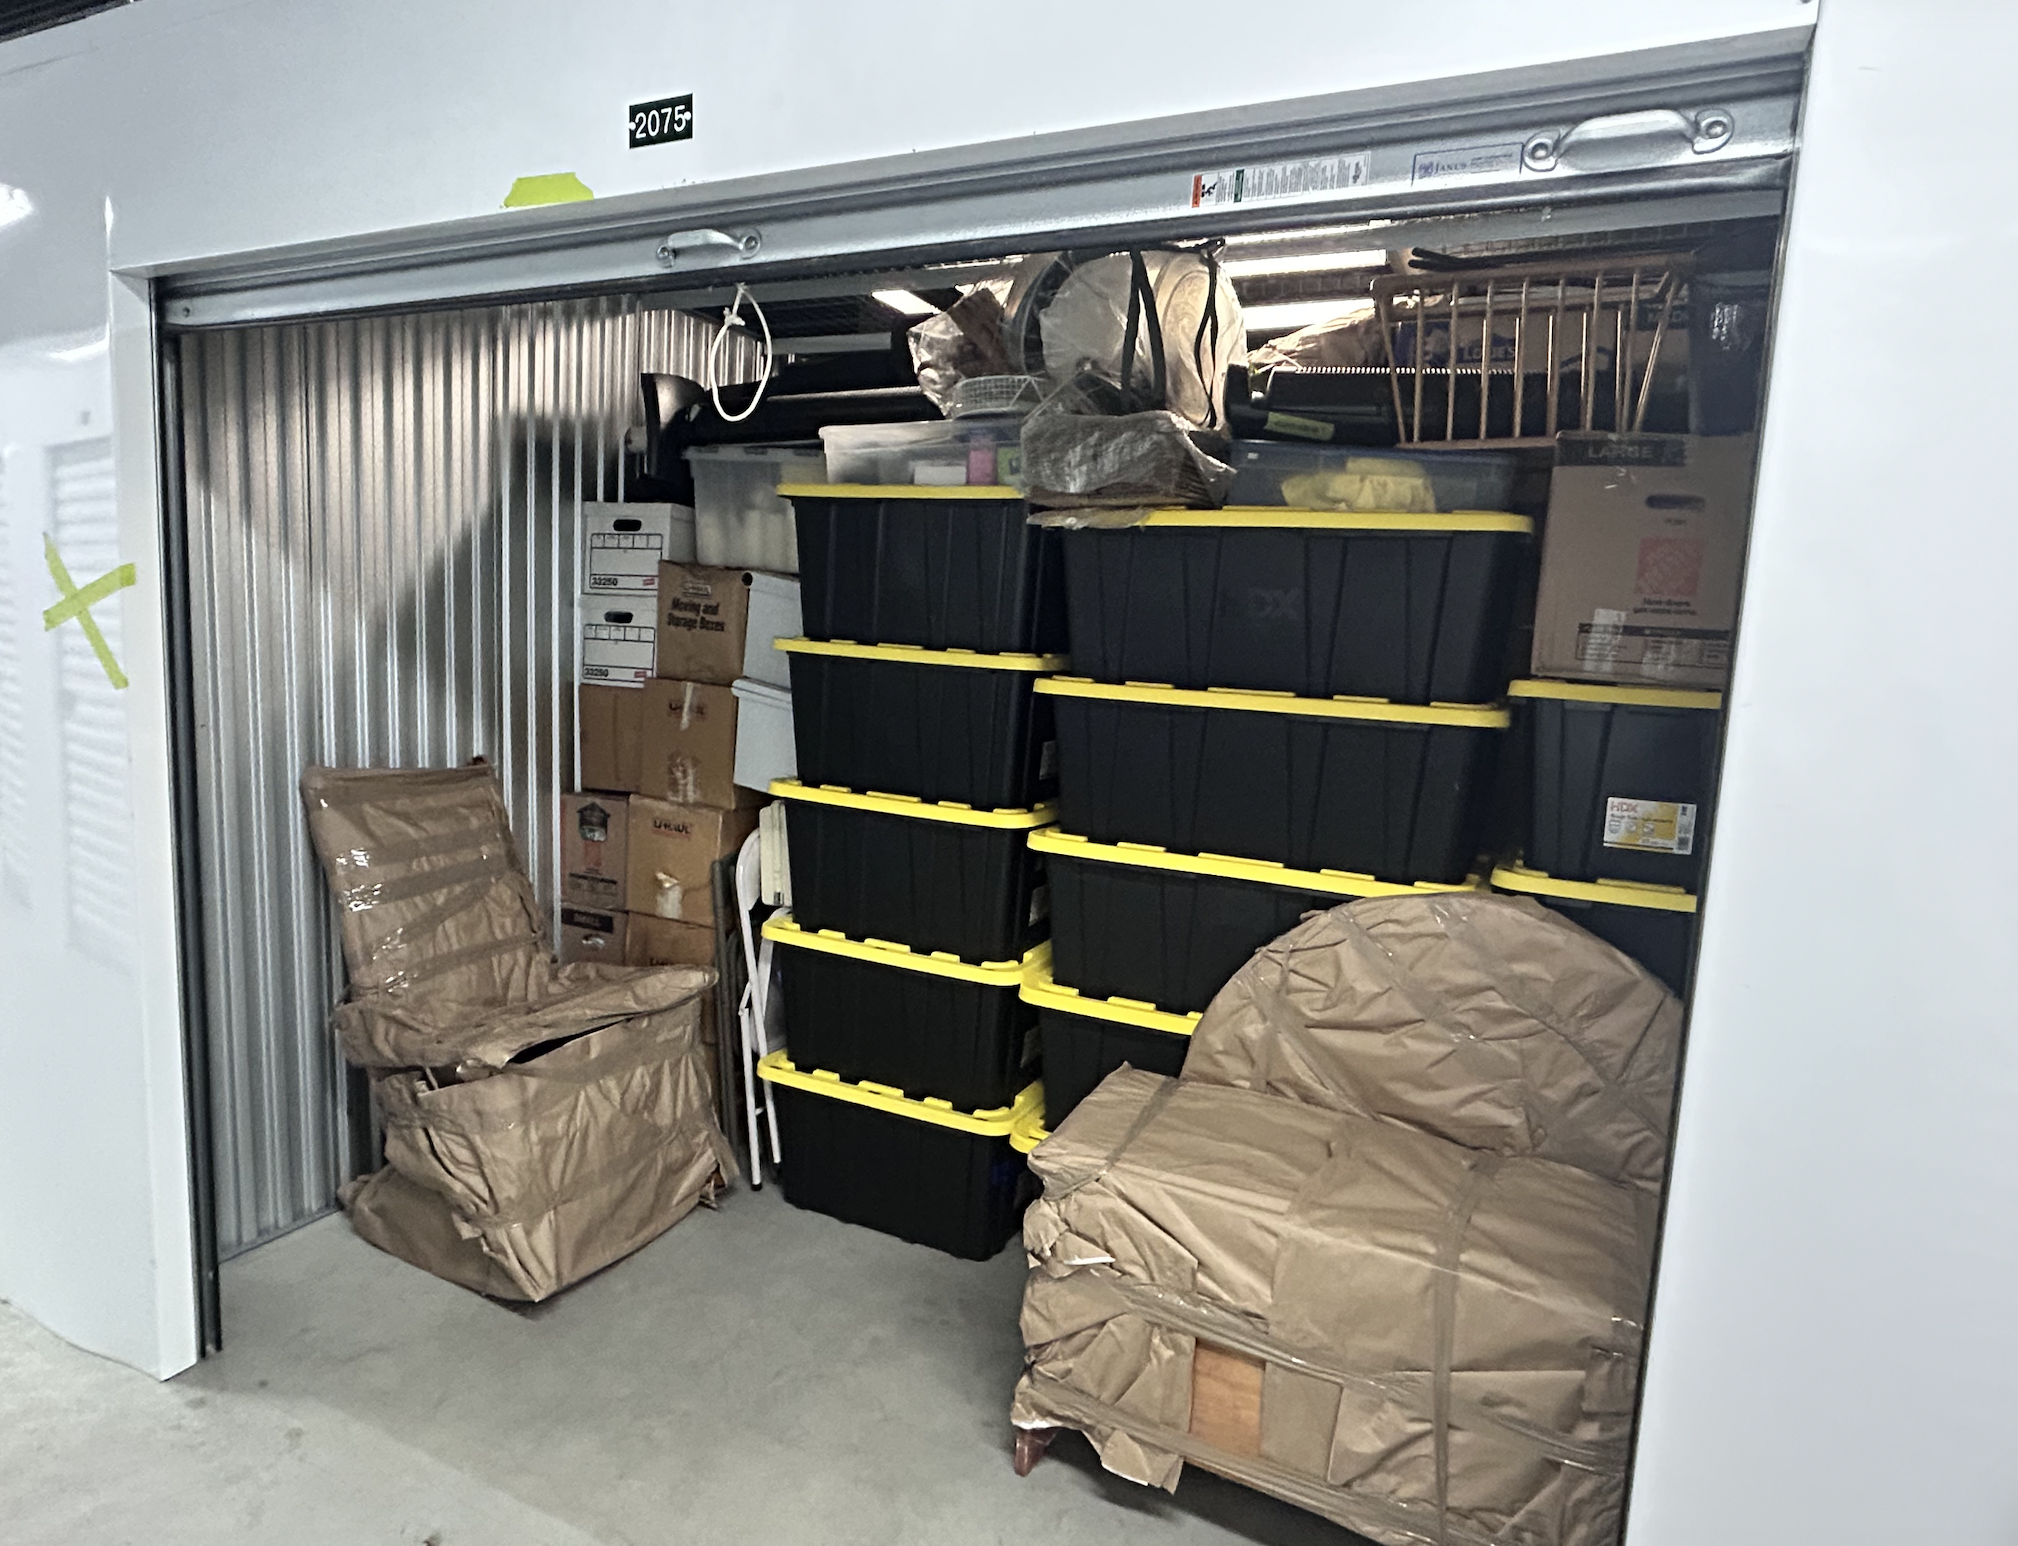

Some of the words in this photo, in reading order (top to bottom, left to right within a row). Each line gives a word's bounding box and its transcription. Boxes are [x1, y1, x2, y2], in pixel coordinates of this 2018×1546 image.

[635, 105, 687, 139] 2075
[1587, 443, 1654, 459] LARGE
[592, 577, 618, 587] 33250
[671, 598, 701, 616] Moving
[702, 602, 720, 616] and
[667, 612, 698, 631] Storage
[699, 616, 725, 632] Boxes
[1610, 801, 1639, 814] HDX
